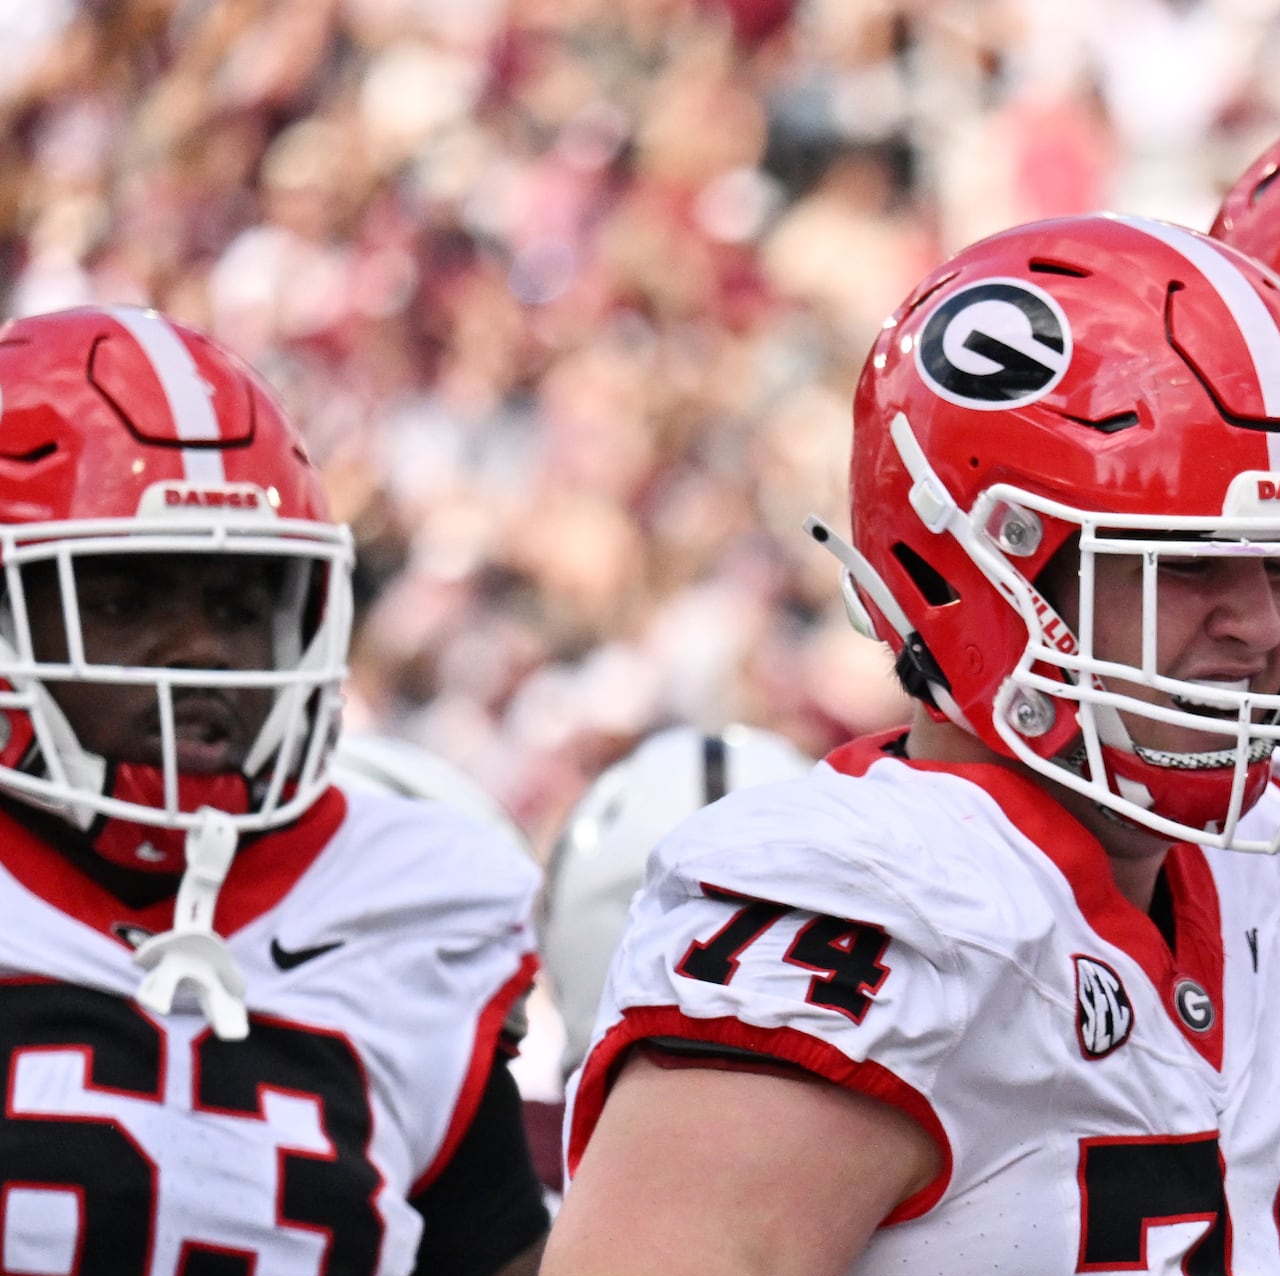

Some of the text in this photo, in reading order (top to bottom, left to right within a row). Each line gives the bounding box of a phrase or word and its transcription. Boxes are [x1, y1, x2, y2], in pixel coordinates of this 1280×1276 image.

[917, 279, 1070, 406] G
[673, 880, 892, 1027] 74
[1076, 957, 1132, 1055] SEC
[1174, 978, 1216, 1034] G
